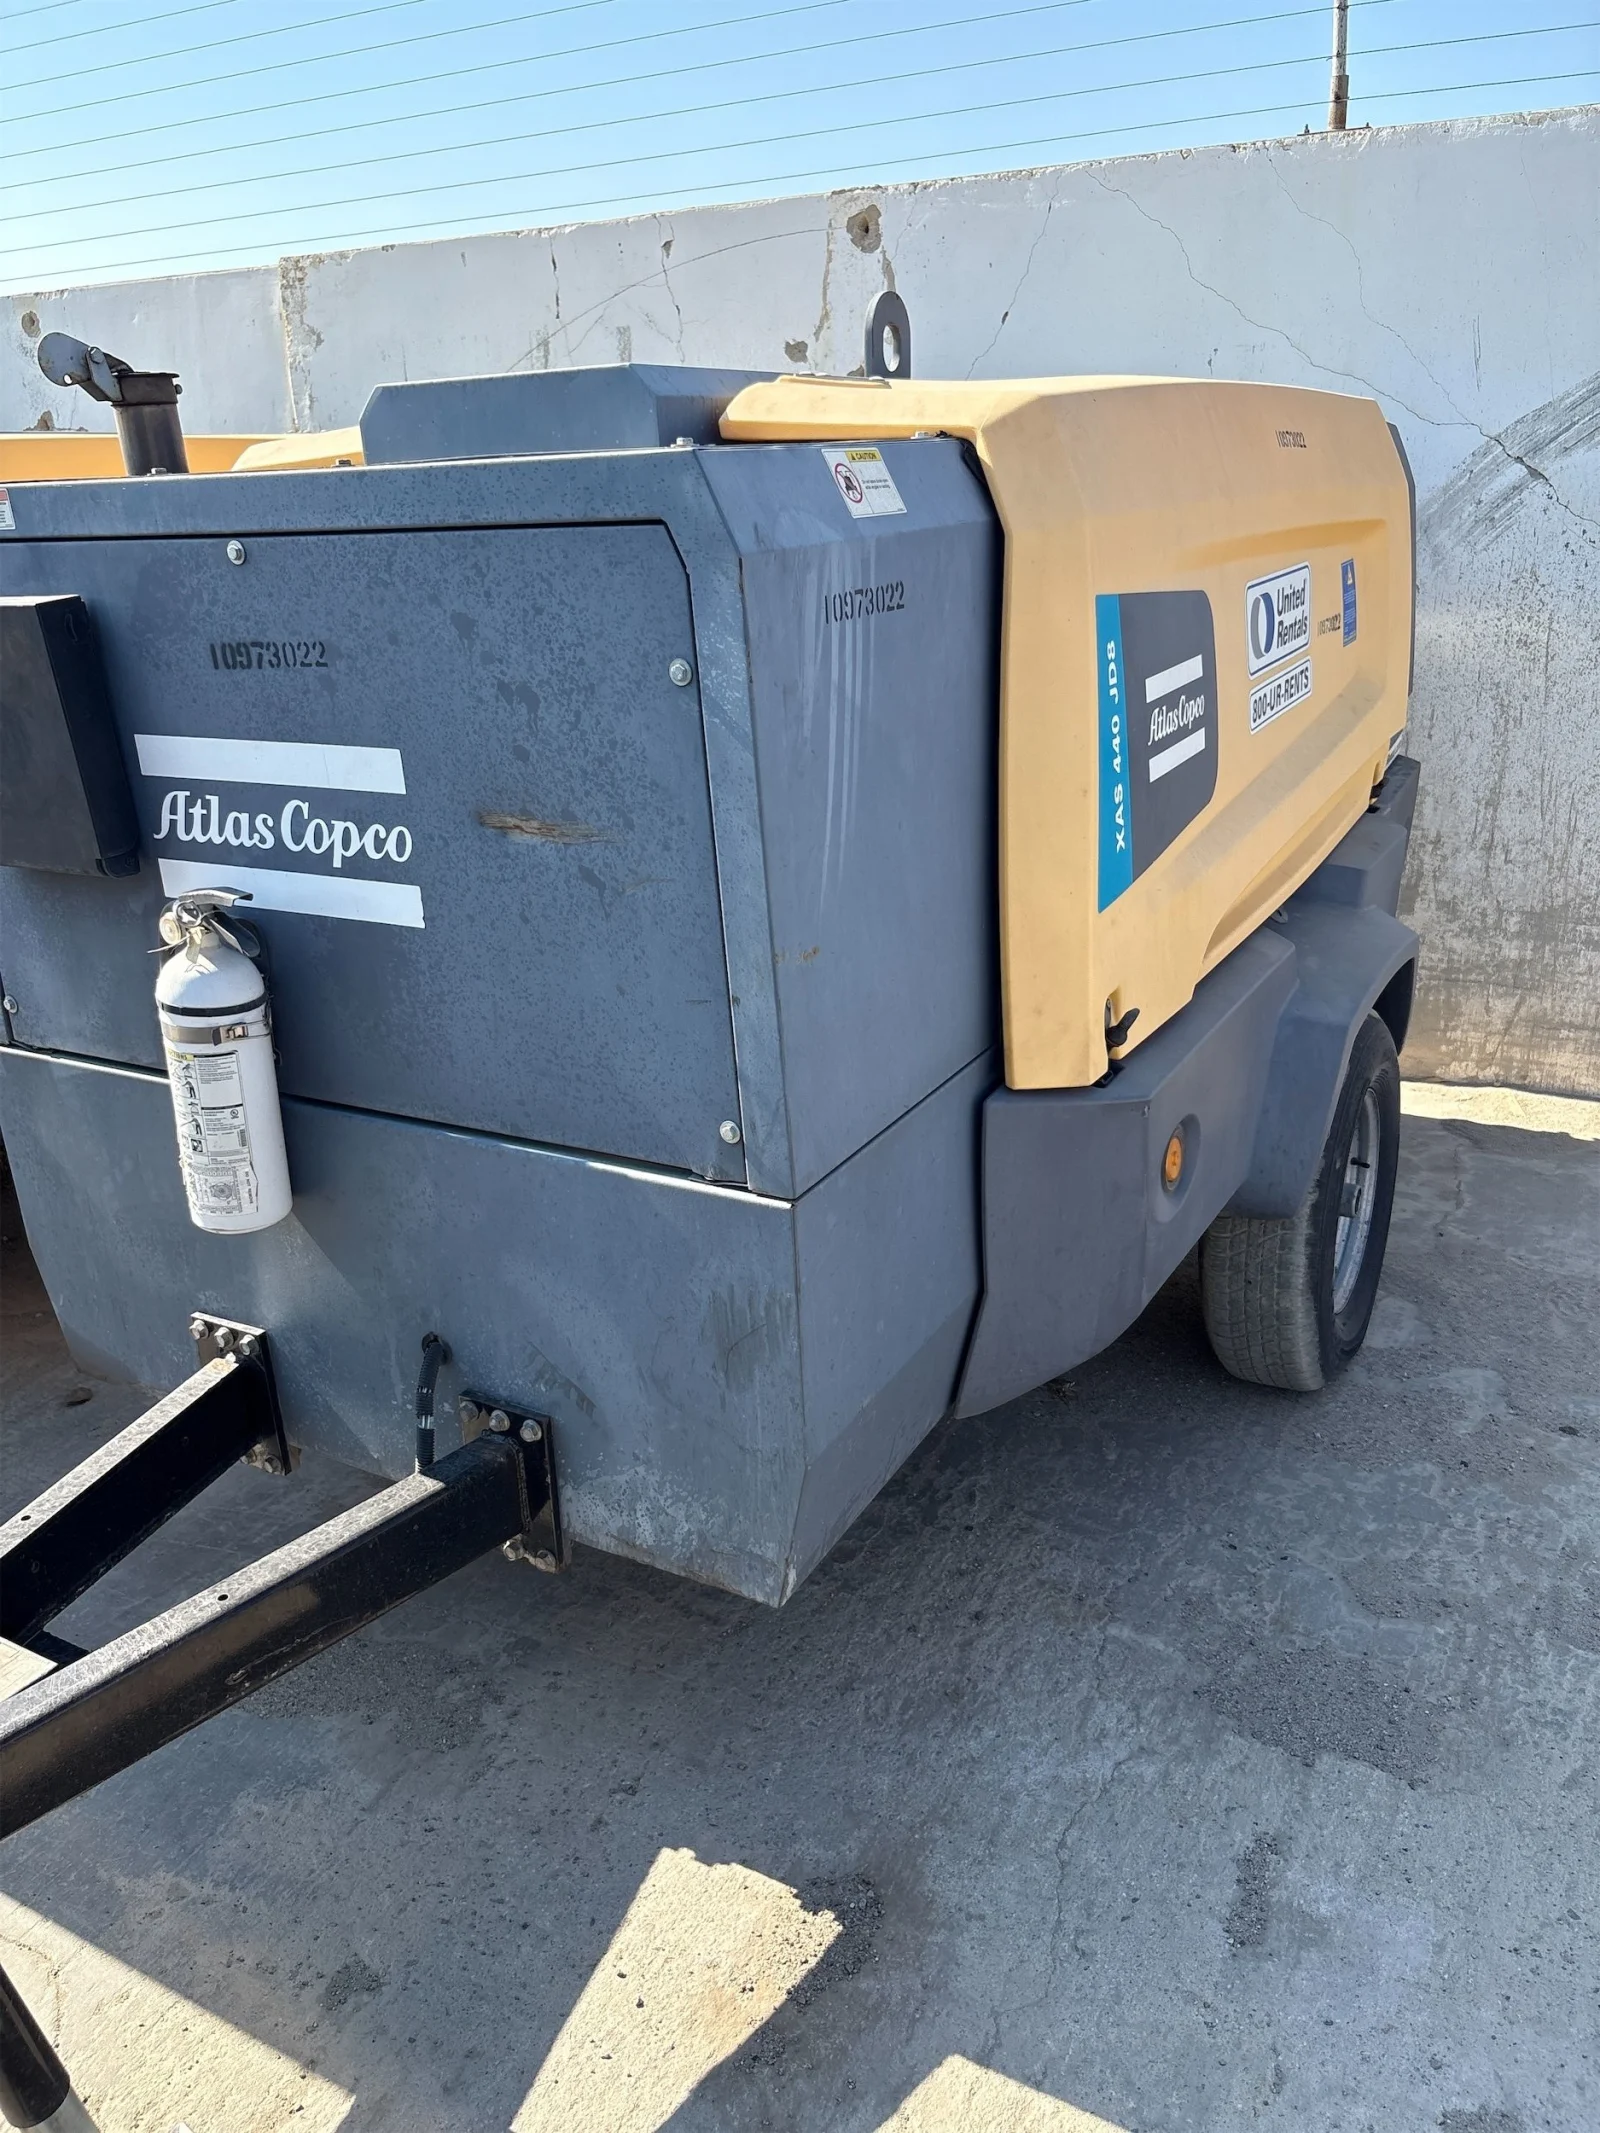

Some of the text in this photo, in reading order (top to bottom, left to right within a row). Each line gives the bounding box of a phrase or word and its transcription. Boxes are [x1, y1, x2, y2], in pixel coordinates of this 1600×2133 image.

[855, 452, 877, 460] CAUTION
[824, 580, 905, 624] 10973022
[1276, 578, 1306, 616] United
[1276, 610, 1308, 648] Rentals
[209, 641, 329, 670] 10973022
[1252, 666, 1309, 723] 800-UR-RENTS
[1148, 694, 1205, 746] Atlas Copco
[1106, 640, 1126, 853] XAS 440 JD8
[153, 790, 413, 868] Atlas Copco
